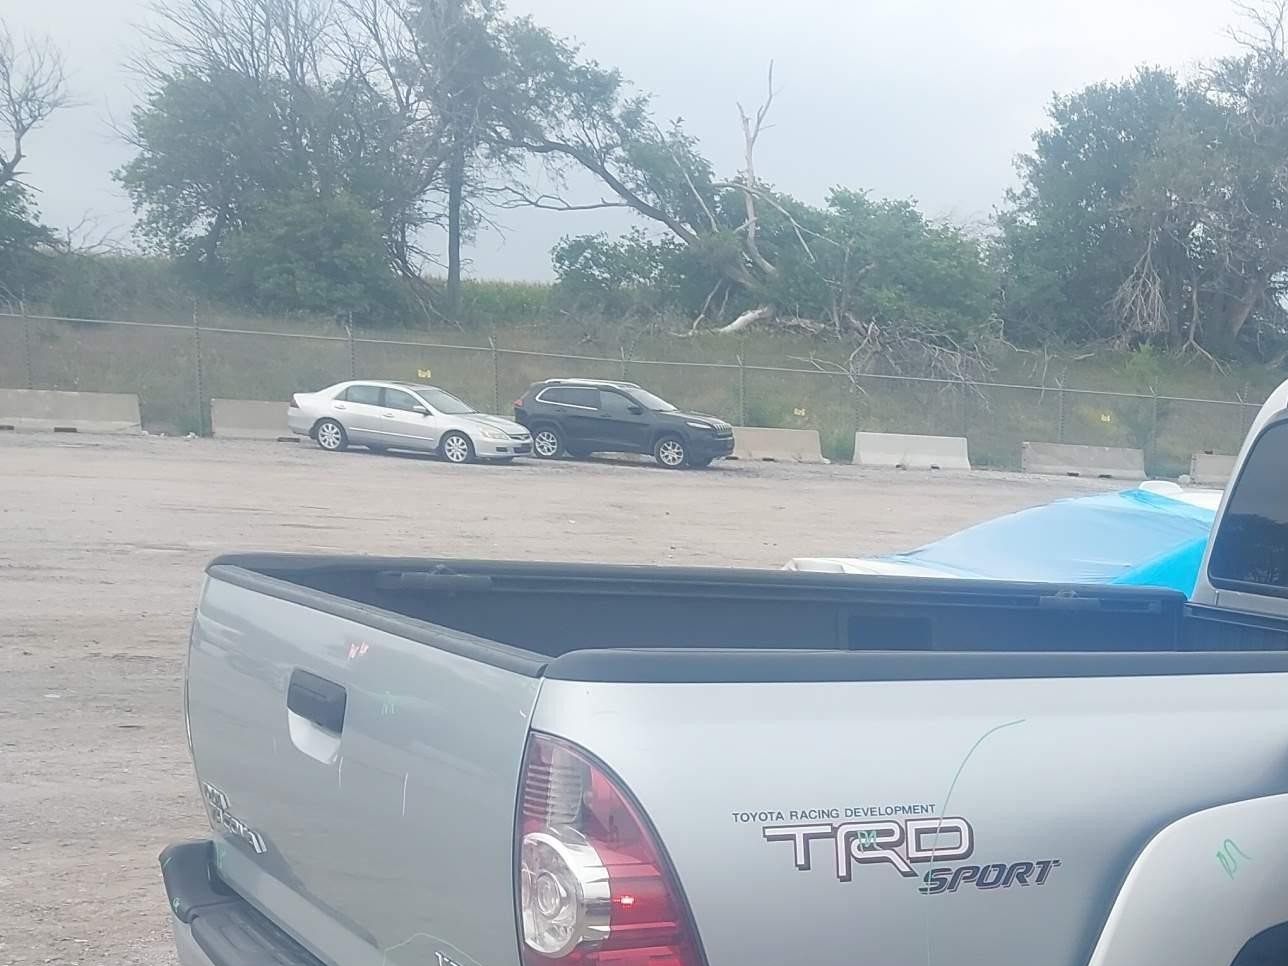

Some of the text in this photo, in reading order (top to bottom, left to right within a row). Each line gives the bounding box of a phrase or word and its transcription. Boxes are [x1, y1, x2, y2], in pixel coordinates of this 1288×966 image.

[732, 803, 936, 823] TOYOTA RACING DEVELOPMENT
[762, 816, 975, 882] TRD
[917, 858, 1062, 895] SPORT
